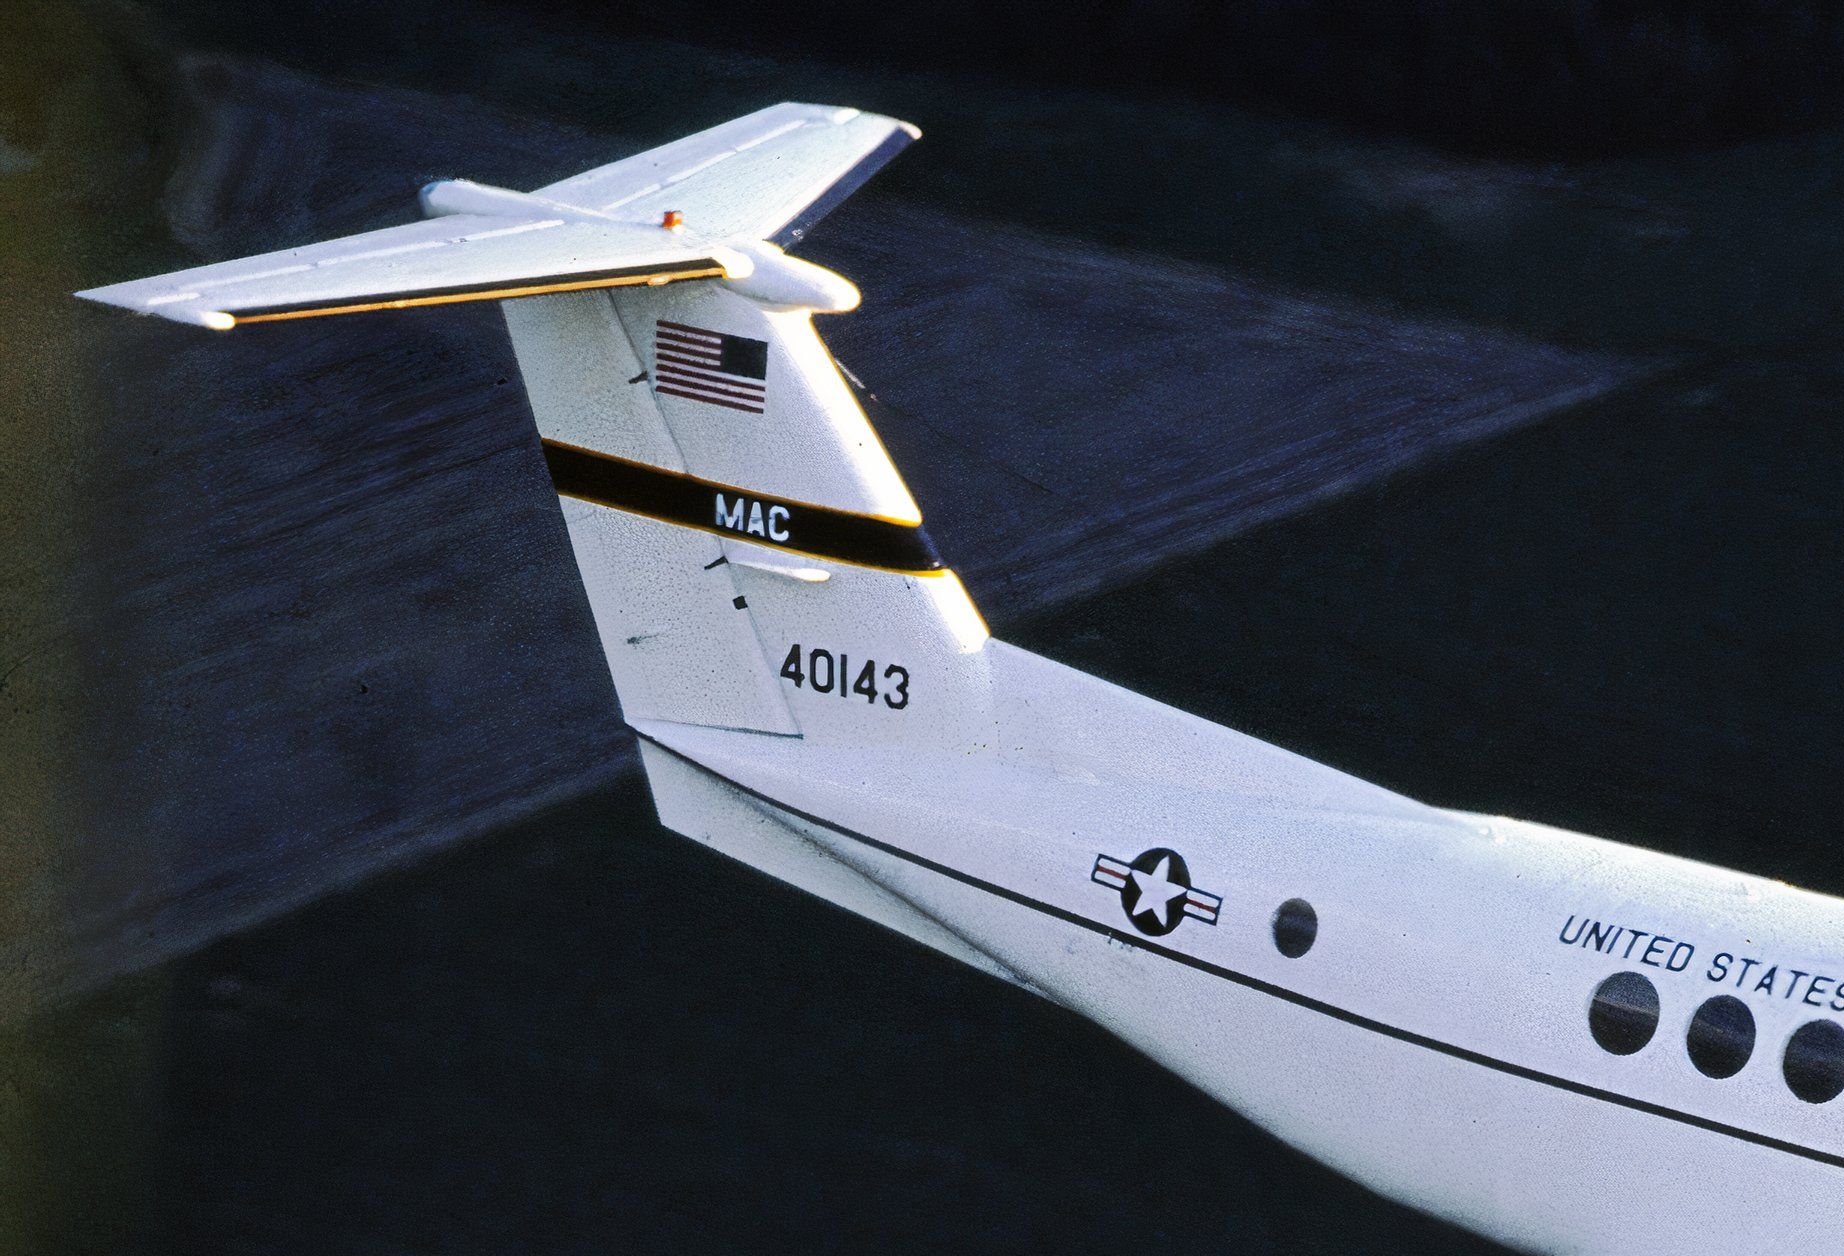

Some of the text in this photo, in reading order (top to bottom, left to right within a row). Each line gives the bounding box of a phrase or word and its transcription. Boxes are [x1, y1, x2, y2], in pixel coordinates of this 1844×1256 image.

[716, 494, 790, 541] MAC
[781, 644, 910, 710] 40143
[1559, 915, 1695, 973] UNITED
